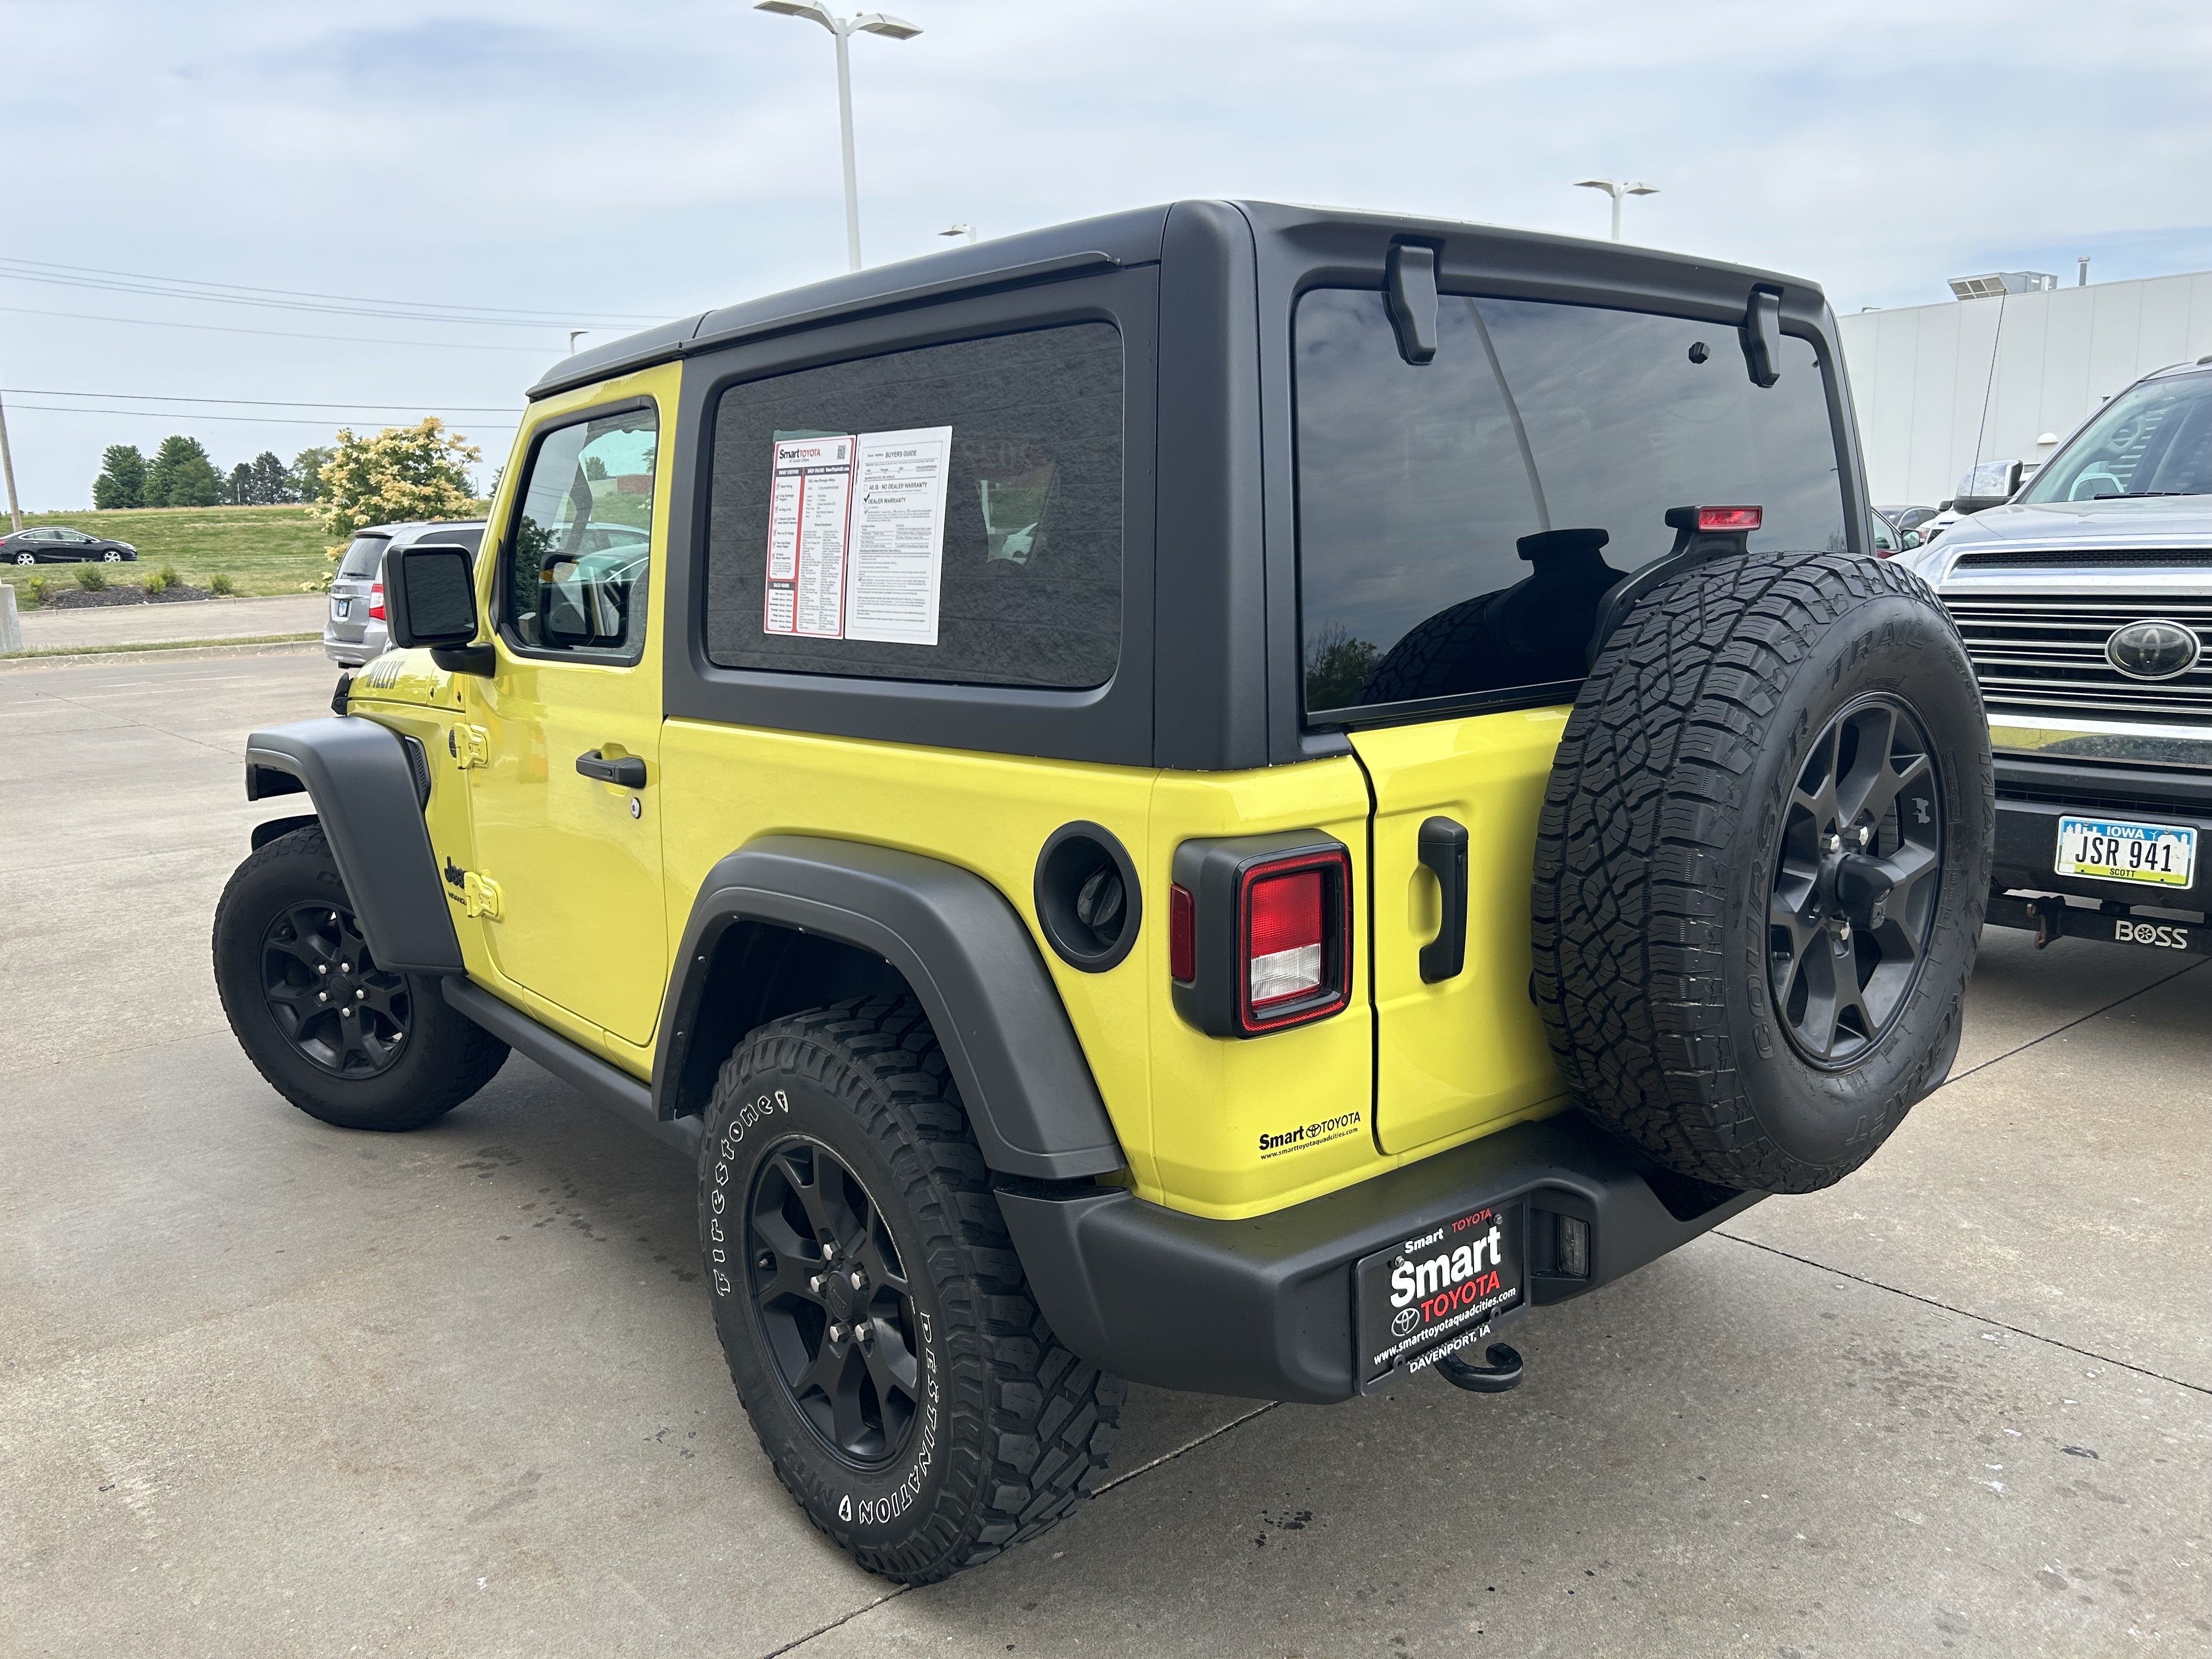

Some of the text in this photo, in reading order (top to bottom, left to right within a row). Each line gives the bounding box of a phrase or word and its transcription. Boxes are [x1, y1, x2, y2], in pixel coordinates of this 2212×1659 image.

[1826, 619, 1925, 690] TRAIL
[2075, 836, 2171, 872] JSR 941
[2106, 826, 2145, 839] IOWA
[444, 856, 466, 889] Jee
[2109, 868, 2136, 878] SCOTT
[2115, 919, 2188, 950] BOSS
[1259, 1111, 1361, 1151] Smart TOYOTA
[1260, 1126, 1358, 1160] www.smarttoyotaquadcities.com
[711, 1095, 773, 1296] Firestone
[1404, 1208, 1492, 1254] Smart TOYOTA
[1390, 1226, 1502, 1308] Smart
[1421, 1270, 1500, 1323] TOYOTA
[1373, 1286, 1516, 1365] www.smarttoyotaquadcities.com
[1409, 1324, 1491, 1374] DAVENPORT, IA
[859, 1312, 940, 1525] DESTINATION
